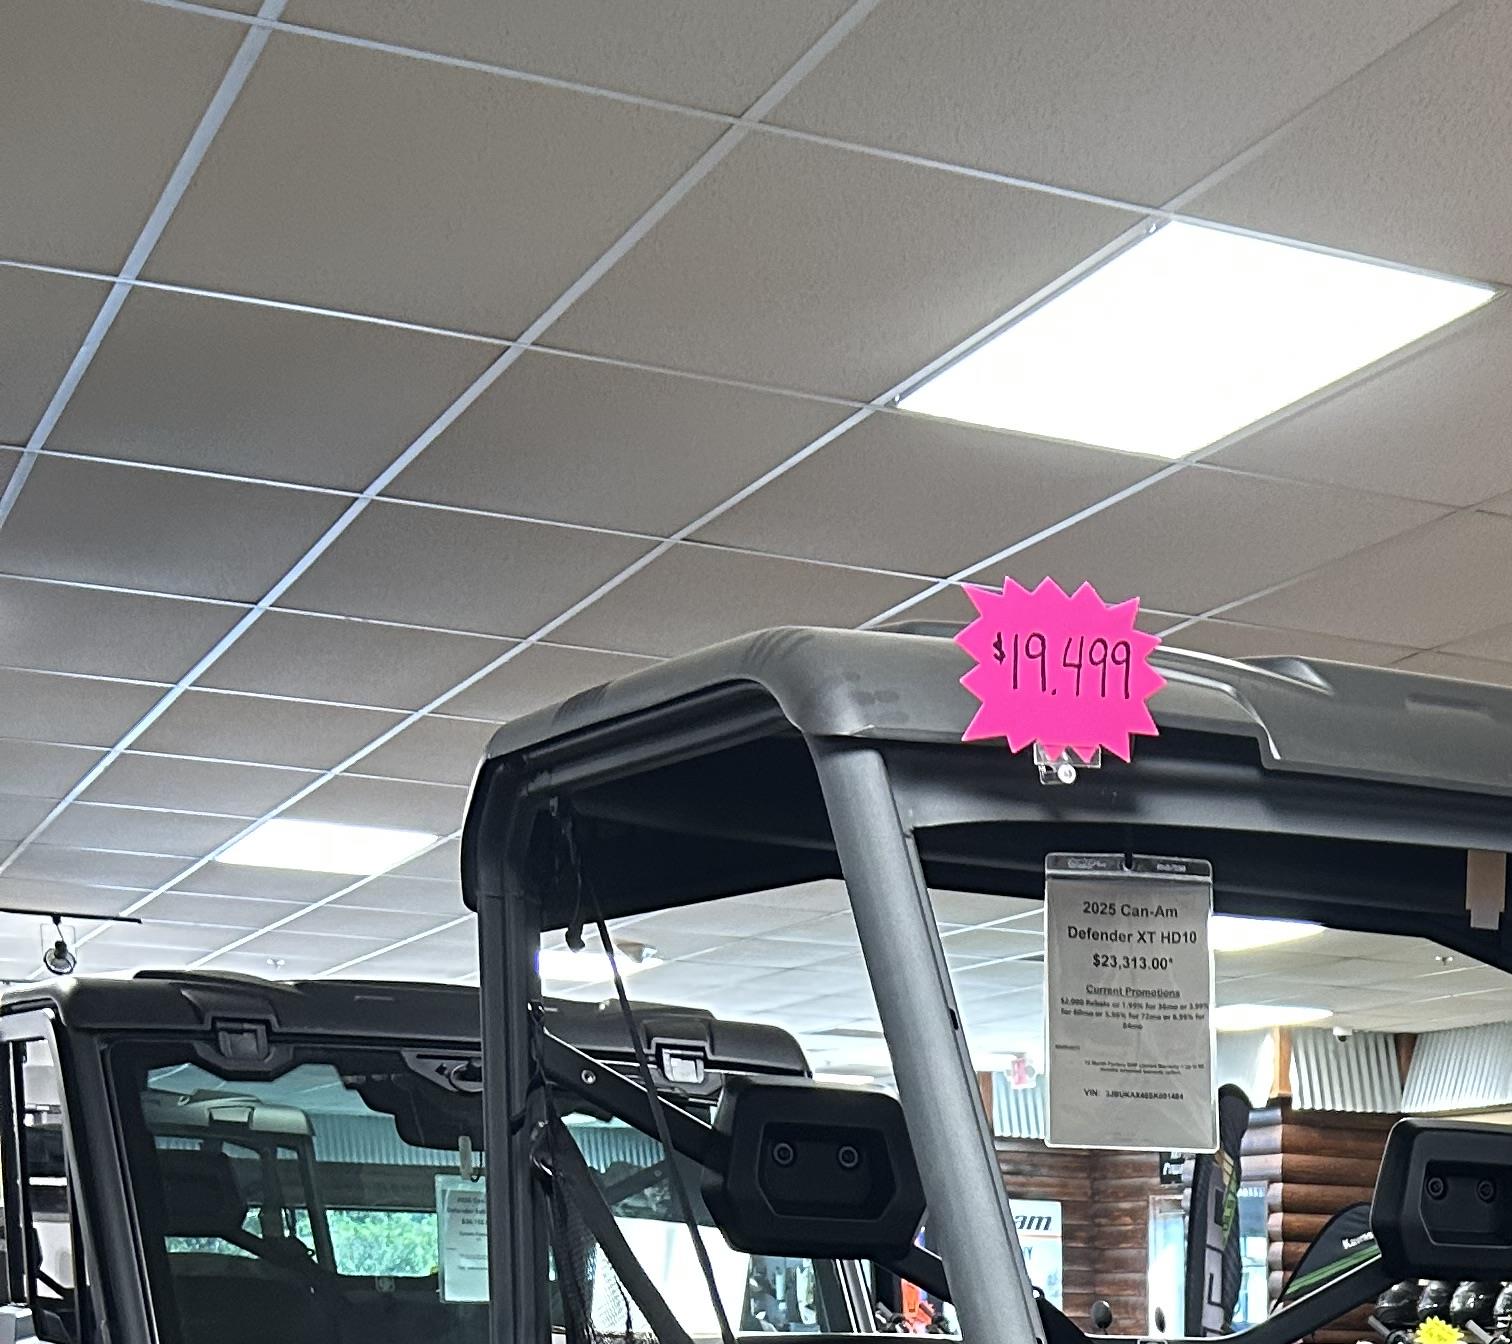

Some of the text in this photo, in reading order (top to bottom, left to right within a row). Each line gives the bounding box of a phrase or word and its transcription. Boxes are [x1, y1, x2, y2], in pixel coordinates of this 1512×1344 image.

[1083, 901, 1179, 918] 2025 Can-Am
[1067, 925, 1198, 944] Defender XT HD10
[1085, 984, 1181, 999] Current Promotions
